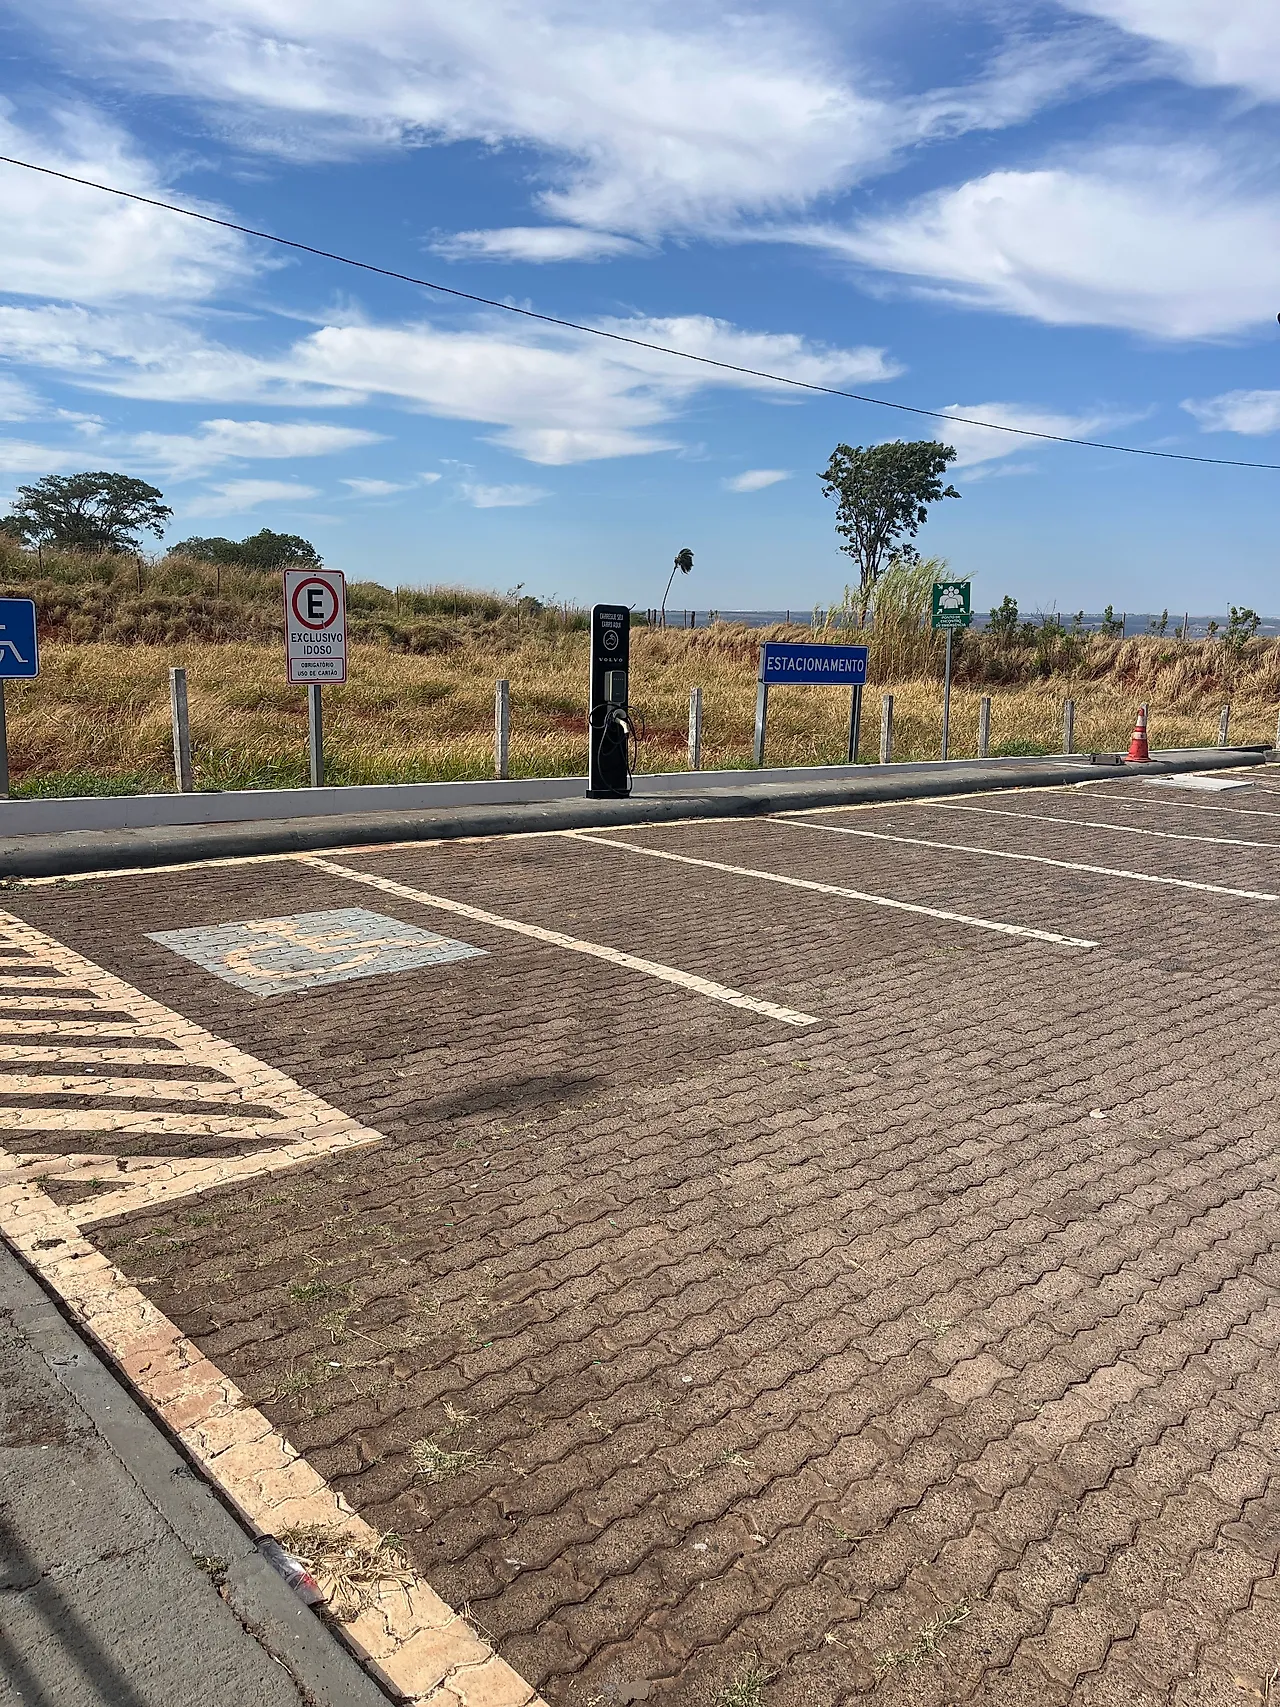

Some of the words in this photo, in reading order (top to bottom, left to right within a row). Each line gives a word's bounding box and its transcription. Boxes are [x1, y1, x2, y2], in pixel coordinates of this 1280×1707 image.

[307, 589, 324, 618] E
[291, 632, 343, 643] EXCLUSIVO
[303, 645, 332, 655] IDOSO
[767, 657, 864, 672] ESTACIONAMENTO
